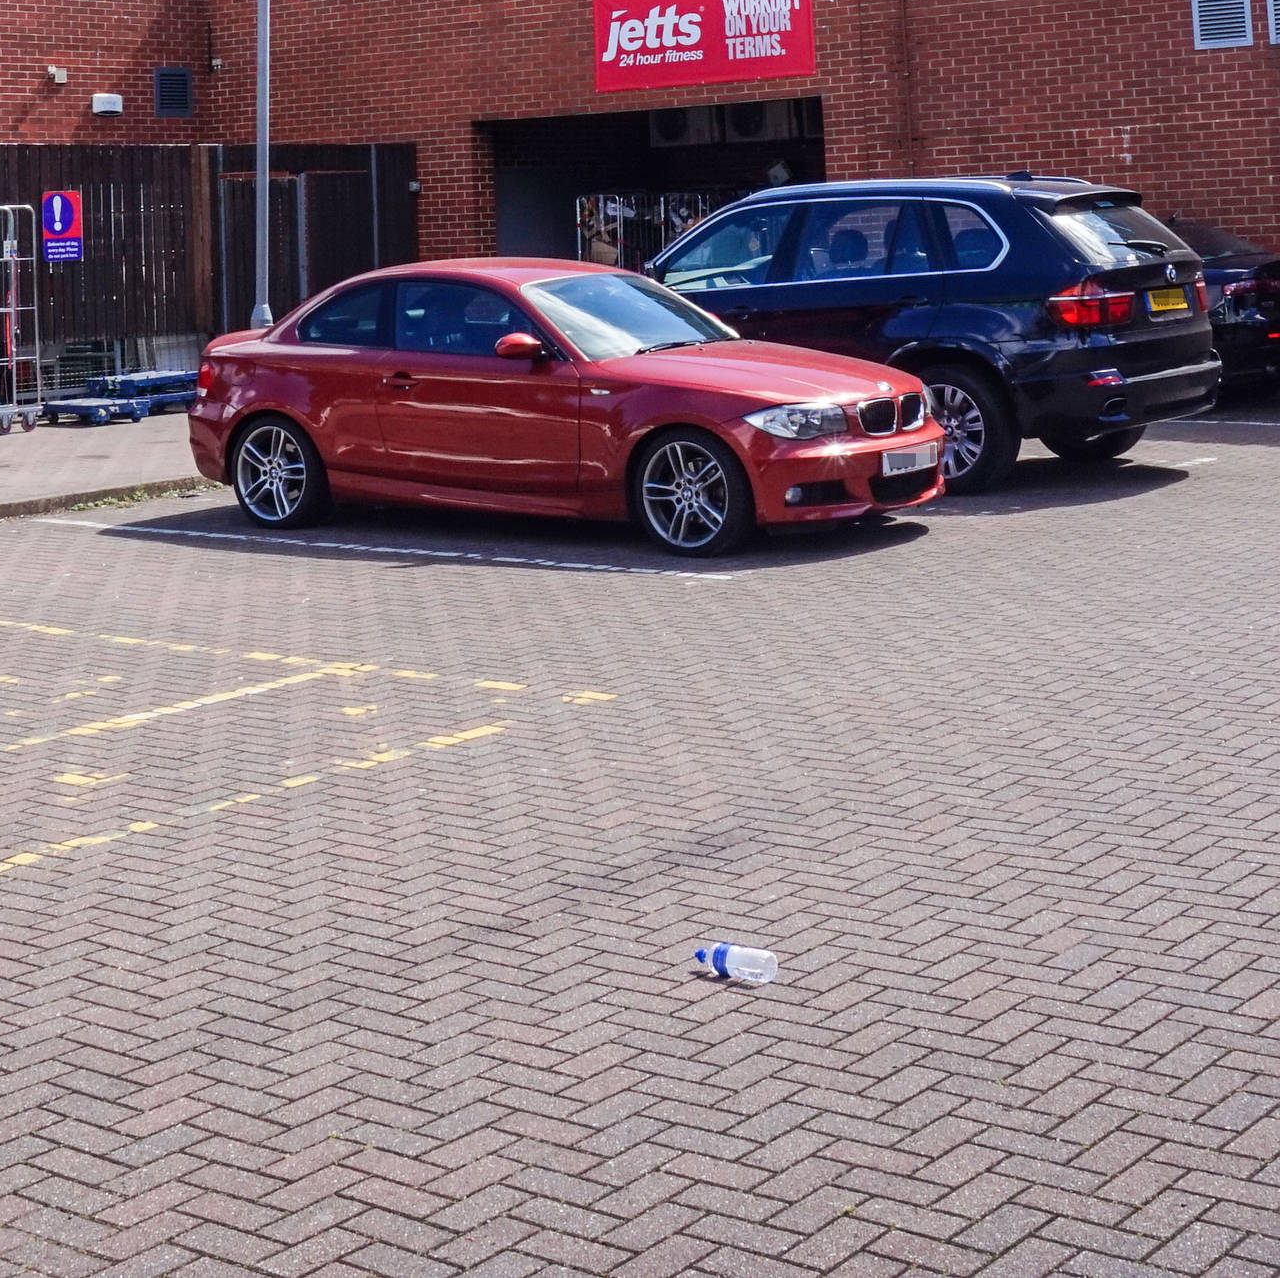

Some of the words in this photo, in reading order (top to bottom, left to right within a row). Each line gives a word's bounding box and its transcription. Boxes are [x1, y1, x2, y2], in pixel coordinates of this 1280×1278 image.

[602, 4, 702, 62] jetts
[725, 14, 746, 37] ON
[750, 10, 791, 34] YOUR
[619, 53, 634, 67] 24
[636, 52, 664, 65] hour
[665, 49, 703, 63] fitness
[725, 34, 786, 60] TERMS.
